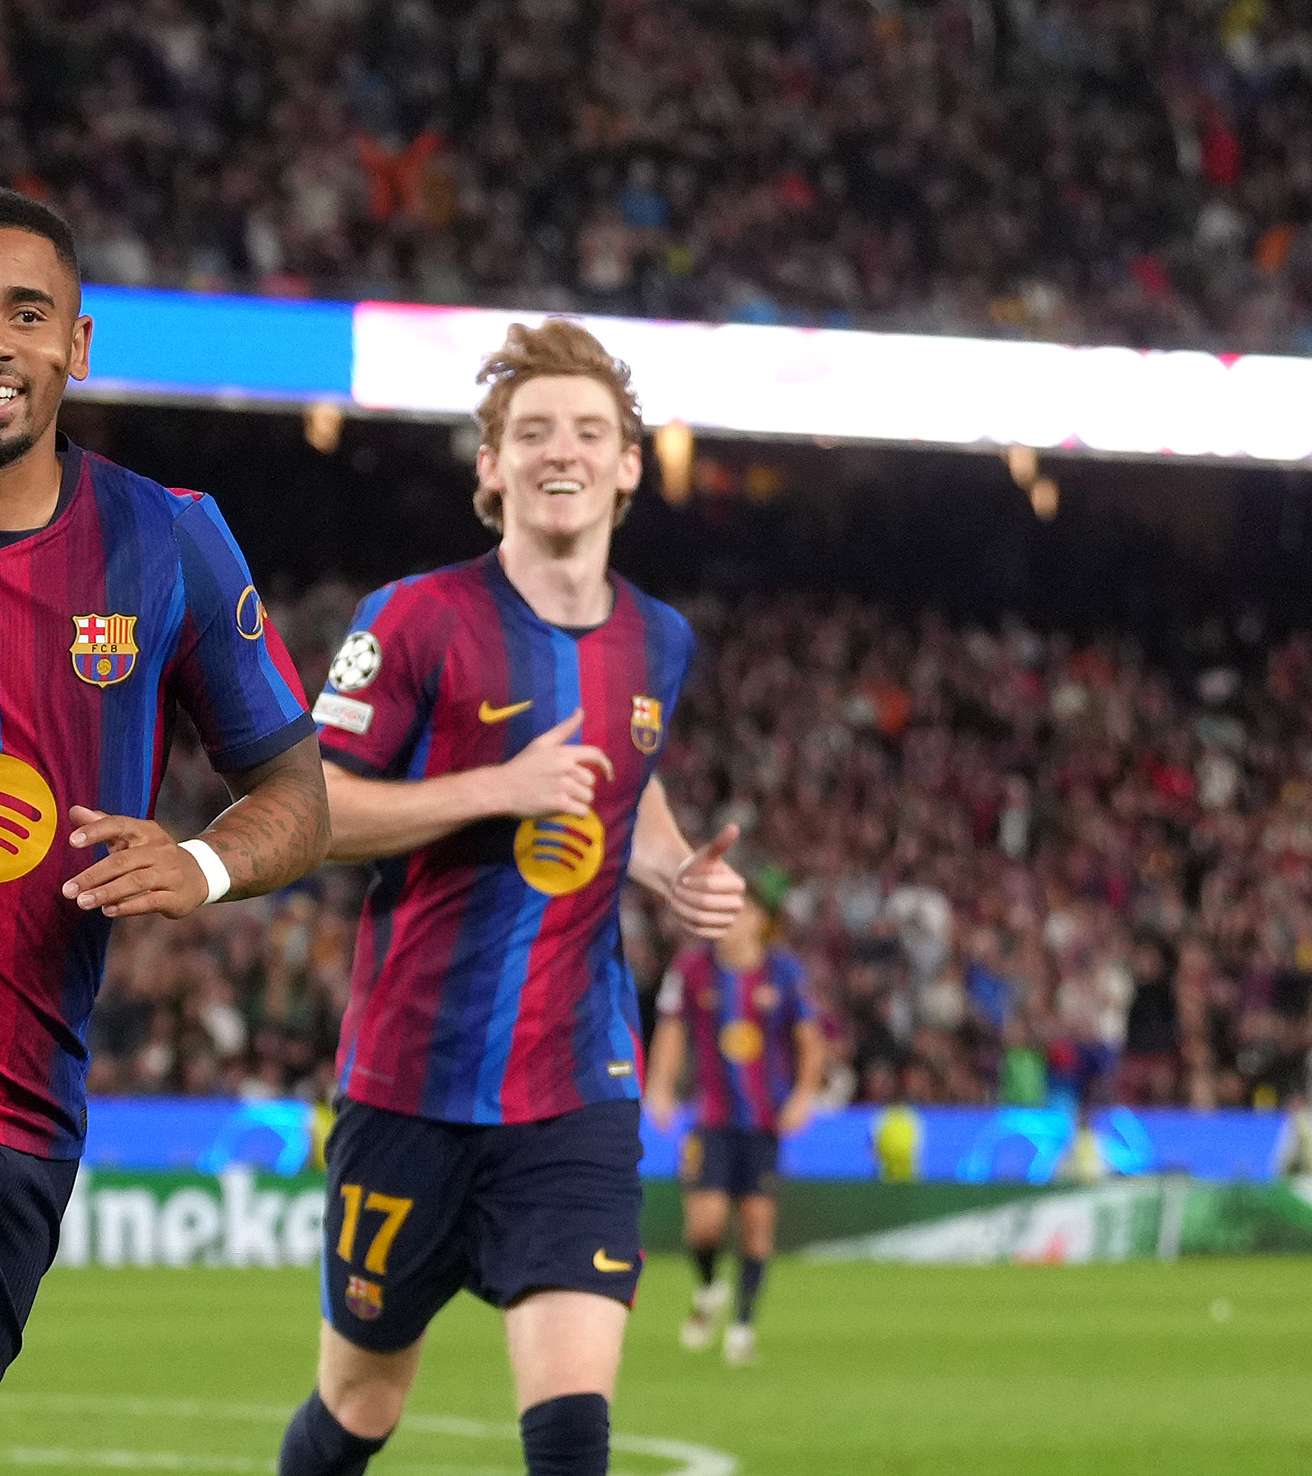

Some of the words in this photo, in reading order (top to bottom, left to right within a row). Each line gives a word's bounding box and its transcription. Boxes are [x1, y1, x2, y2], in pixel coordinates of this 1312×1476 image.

[91, 644, 118, 653] FCB
[58, 1162, 328, 1268] ineke
[337, 1184, 414, 1276] 17
